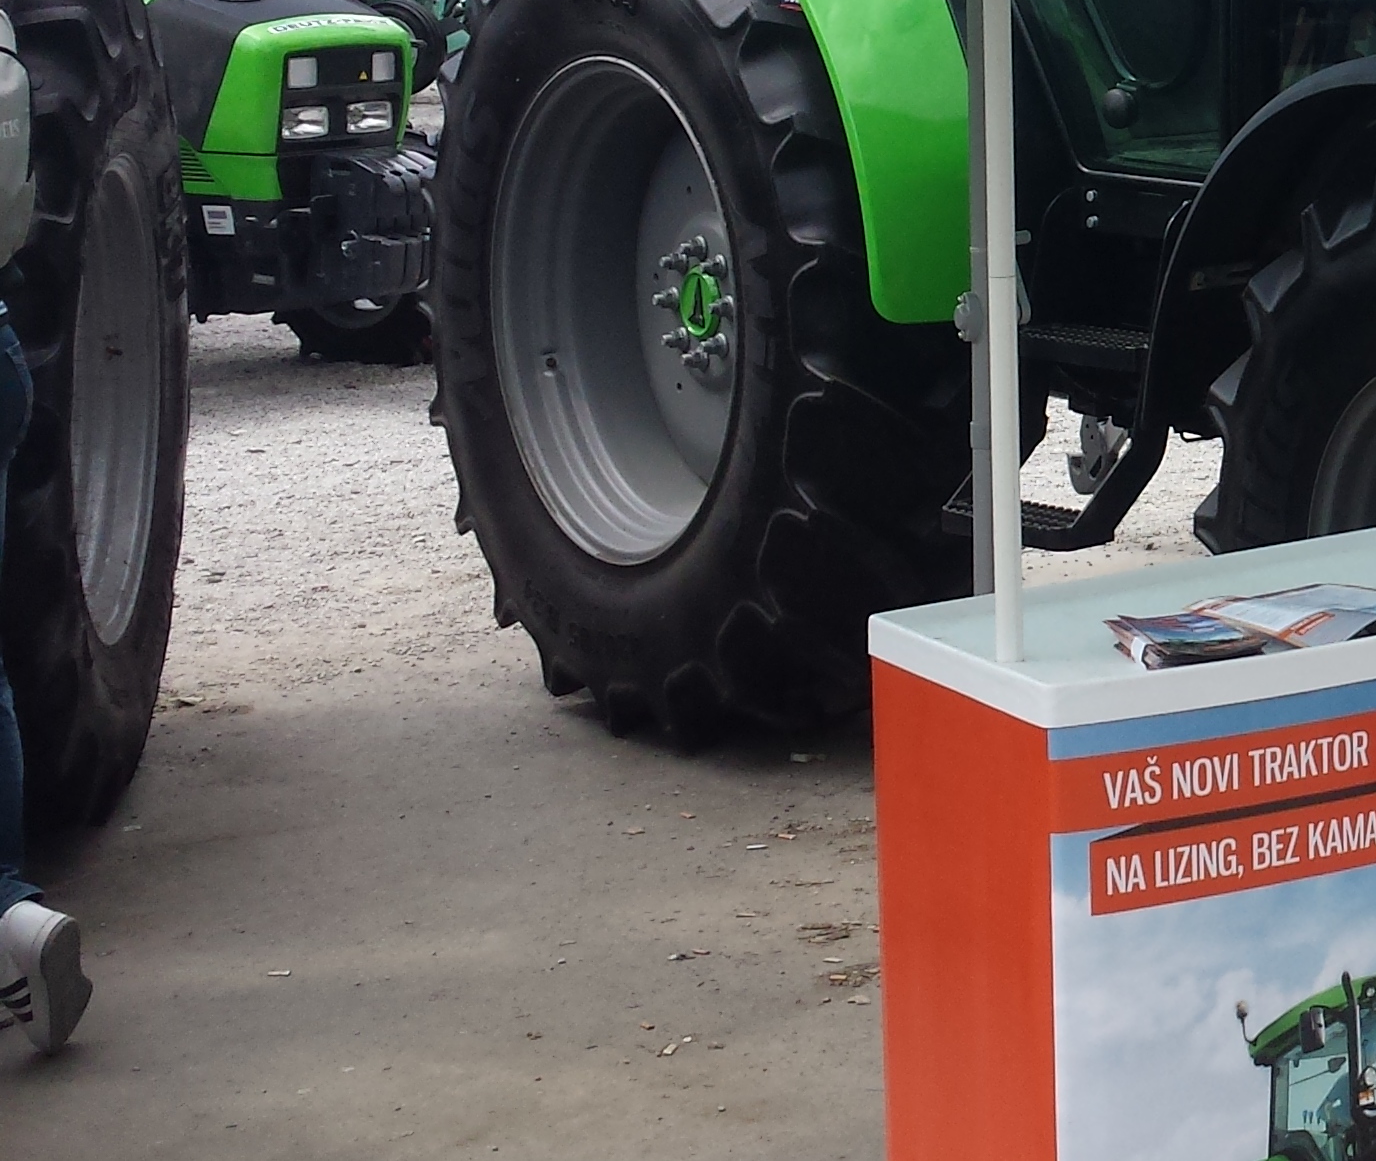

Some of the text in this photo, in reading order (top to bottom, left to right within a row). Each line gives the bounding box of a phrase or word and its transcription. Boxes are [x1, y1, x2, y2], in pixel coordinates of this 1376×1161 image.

[1103, 730, 1370, 809] VAŠ NOVI TRAKTOR
[1106, 853, 1147, 896] NA
[1154, 837, 1245, 889] LIZING,
[1251, 825, 1300, 871] BEZ
